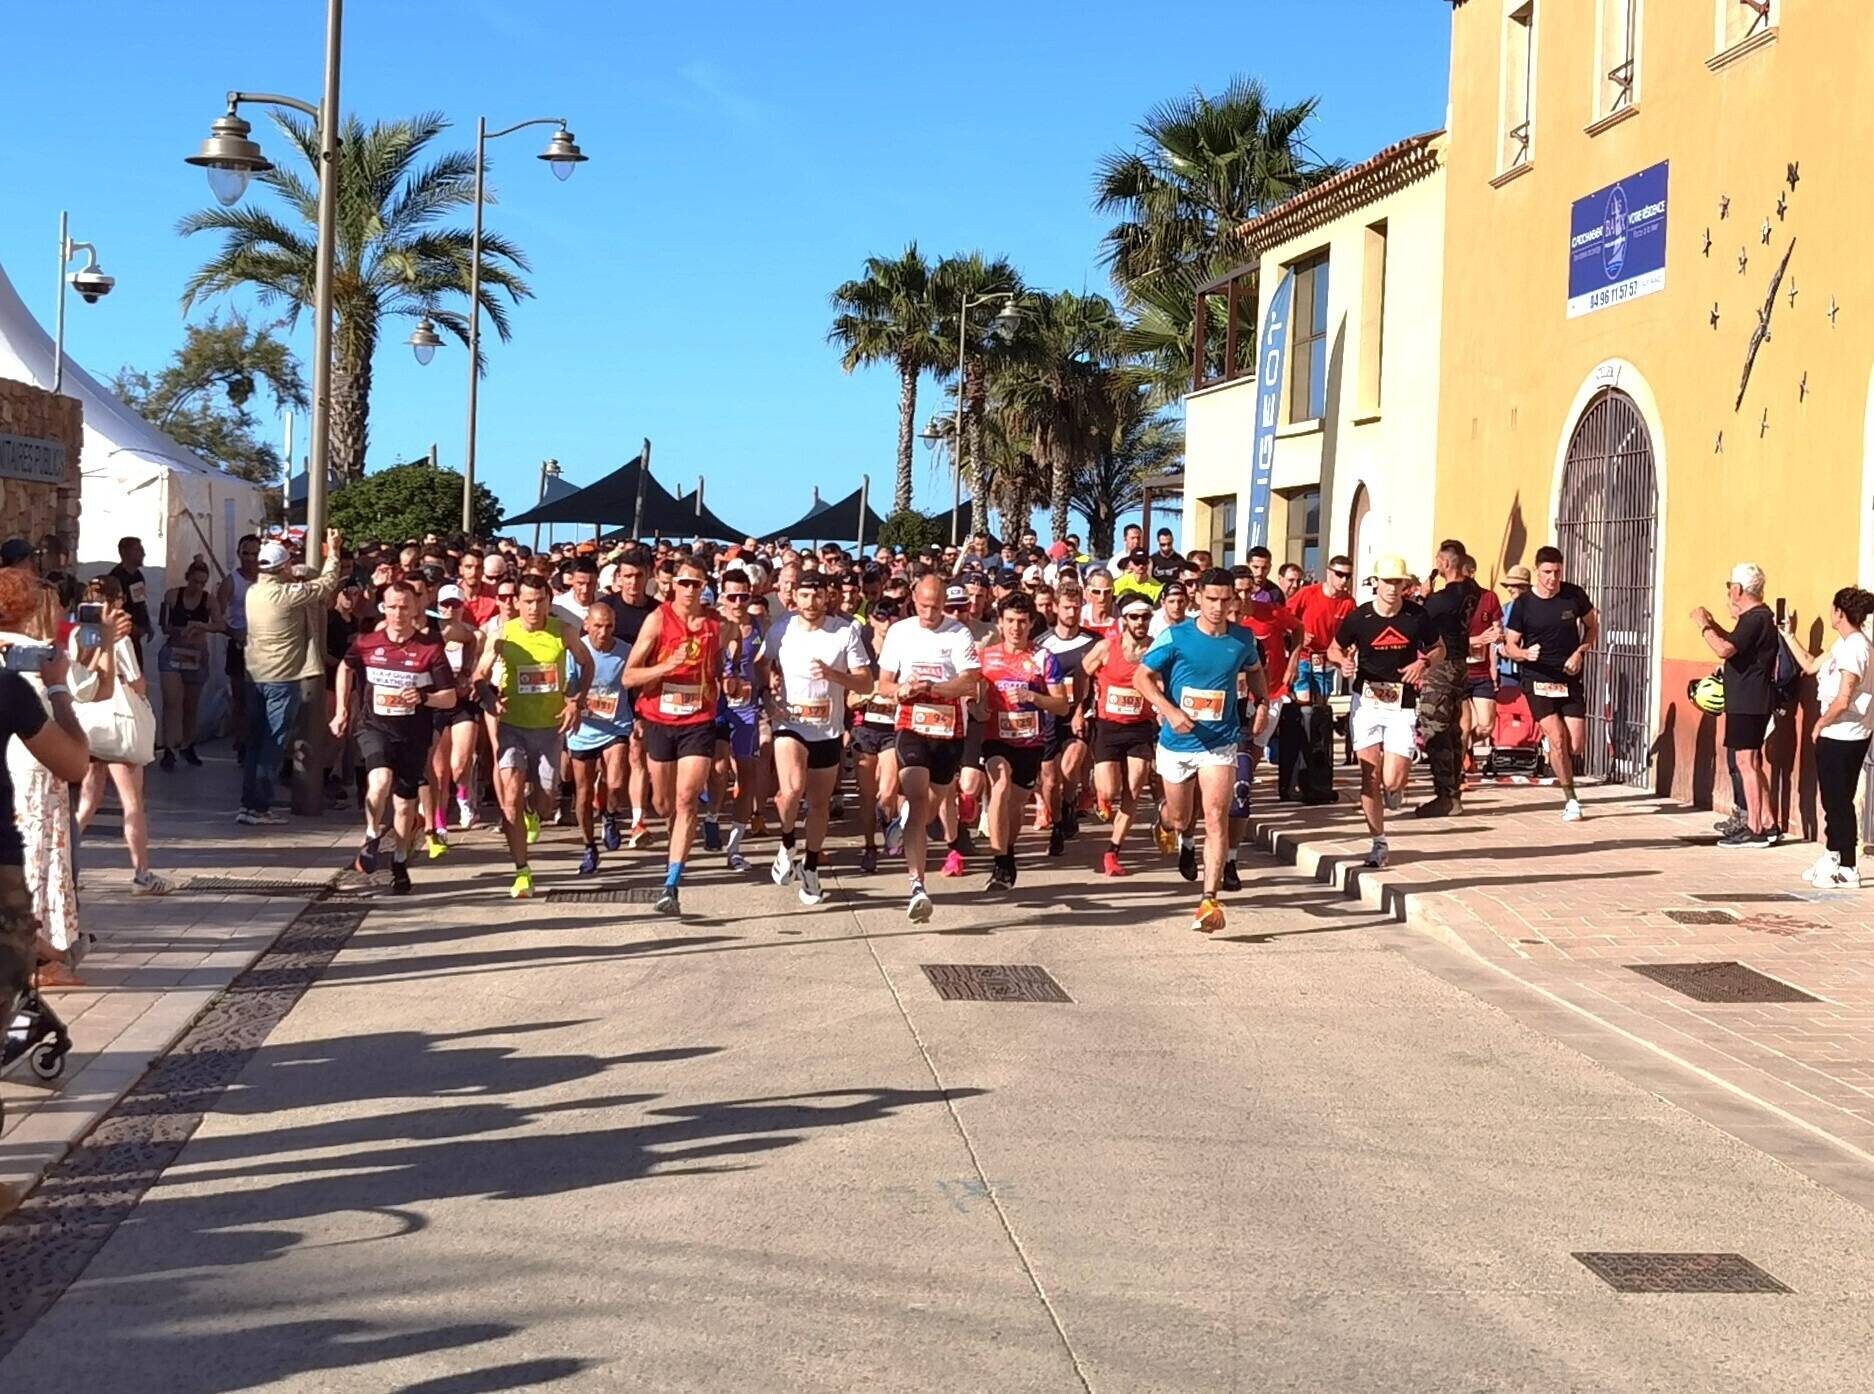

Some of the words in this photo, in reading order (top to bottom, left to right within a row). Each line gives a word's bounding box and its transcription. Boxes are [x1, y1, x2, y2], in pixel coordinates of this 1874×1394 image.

[1600, 290, 1610, 306] 96
[1619, 284, 1628, 300] 57
[1629, 280, 1638, 297] 57
[1205, 699, 1213, 707] 7
